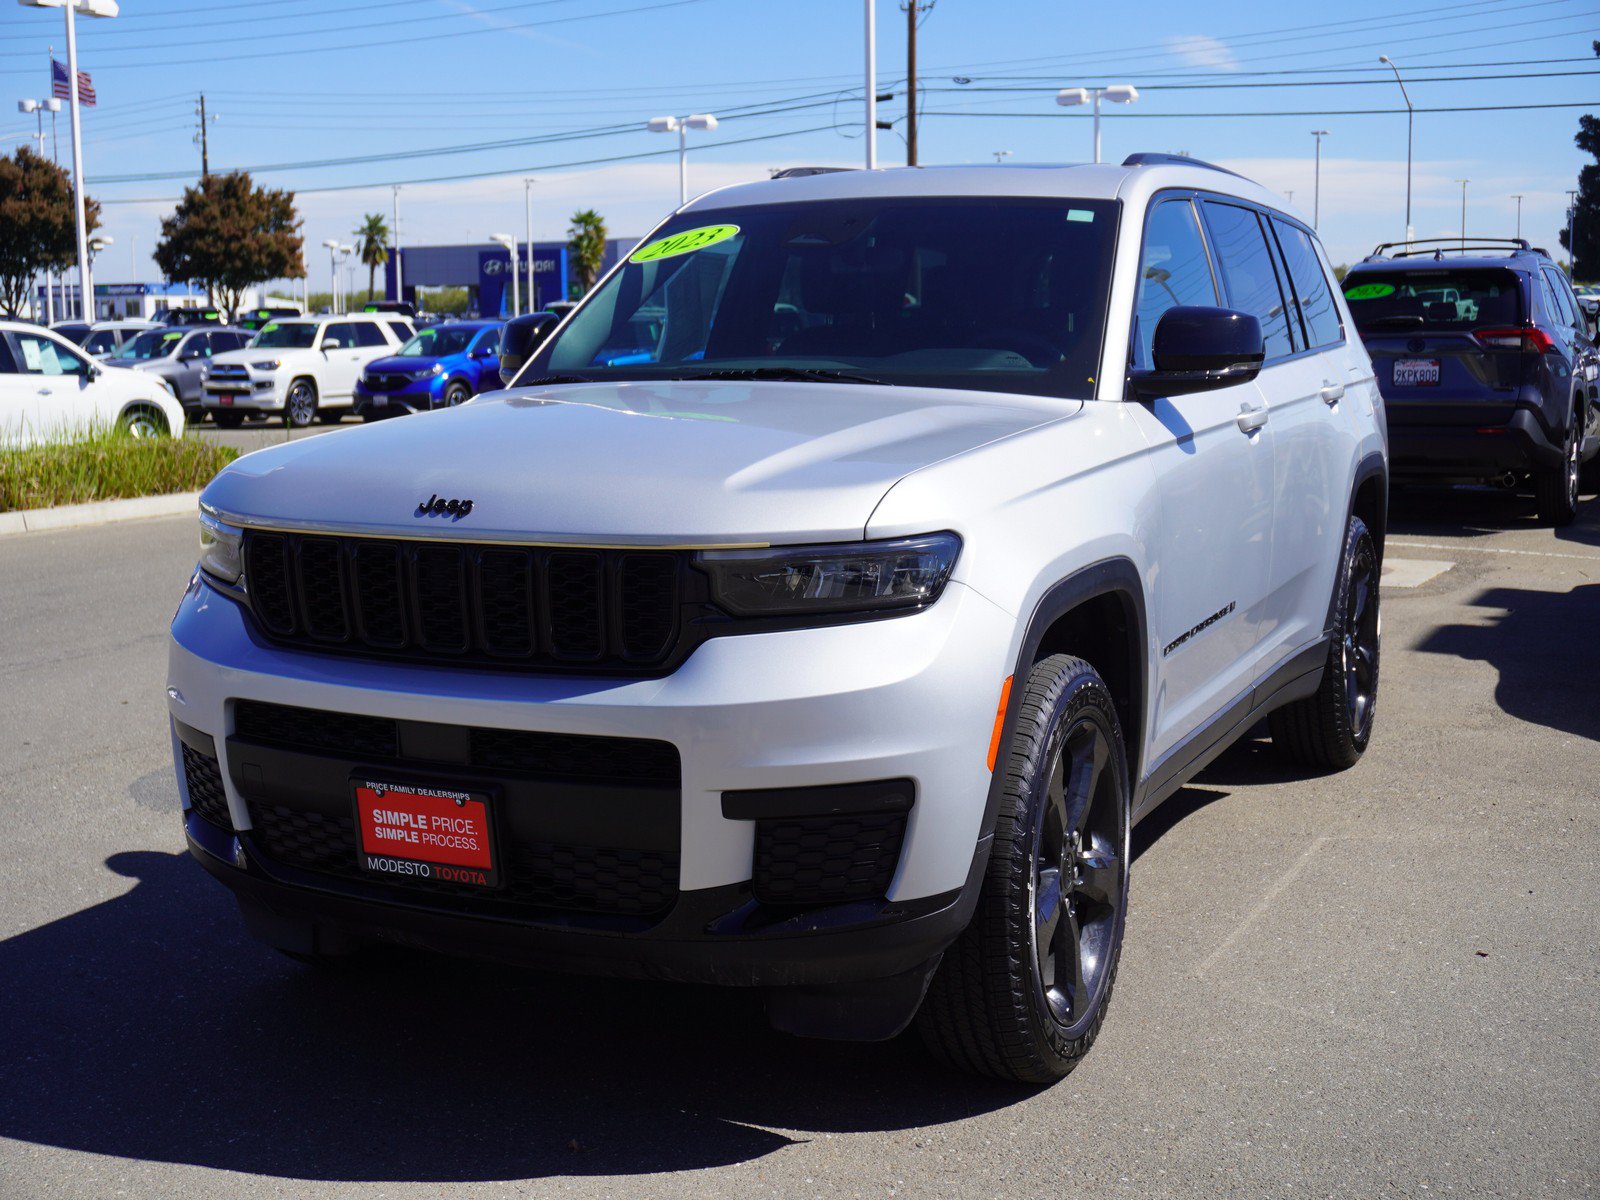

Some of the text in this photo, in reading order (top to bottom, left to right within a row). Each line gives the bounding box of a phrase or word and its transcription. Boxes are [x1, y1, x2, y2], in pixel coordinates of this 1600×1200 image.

[640, 228, 723, 259] 2023
[505, 260, 555, 273] HUDAI
[1395, 369, 1437, 383] 9KPK808
[418, 494, 474, 519] Jeep
[365, 781, 471, 801] PRICE FAMILY DEALERSHIPS
[372, 808, 478, 835] SIMPLE PRICE.
[374, 826, 481, 851] SIMPLE PROCESS.
[367, 856, 487, 886] MODESTO TOYOTA
